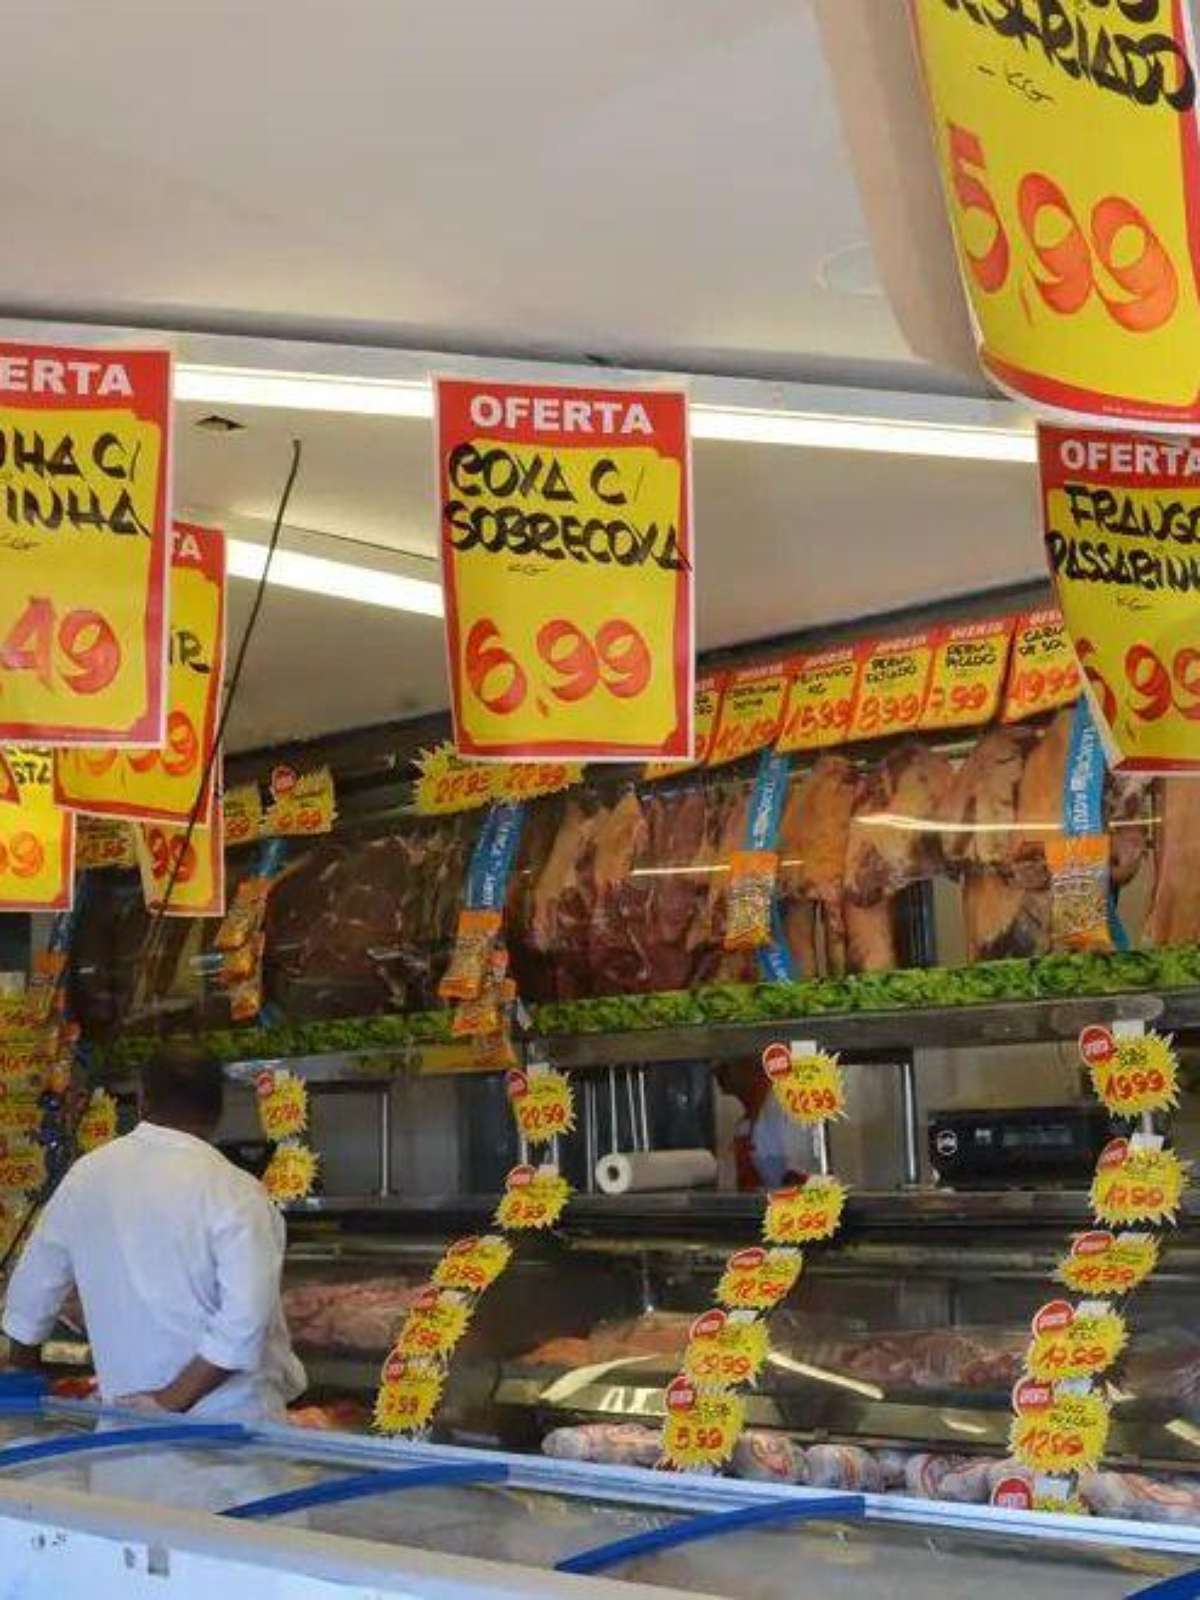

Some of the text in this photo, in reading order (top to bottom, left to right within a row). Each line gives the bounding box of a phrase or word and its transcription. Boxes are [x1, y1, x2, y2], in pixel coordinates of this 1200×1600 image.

[469, 395, 654, 434] OFERTA
[449, 442, 578, 503] COXA
[443, 500, 692, 571] SOBRECOXA
[1045, 530, 1200, 592] PASSARIN
[465, 617, 653, 718] 6,99
